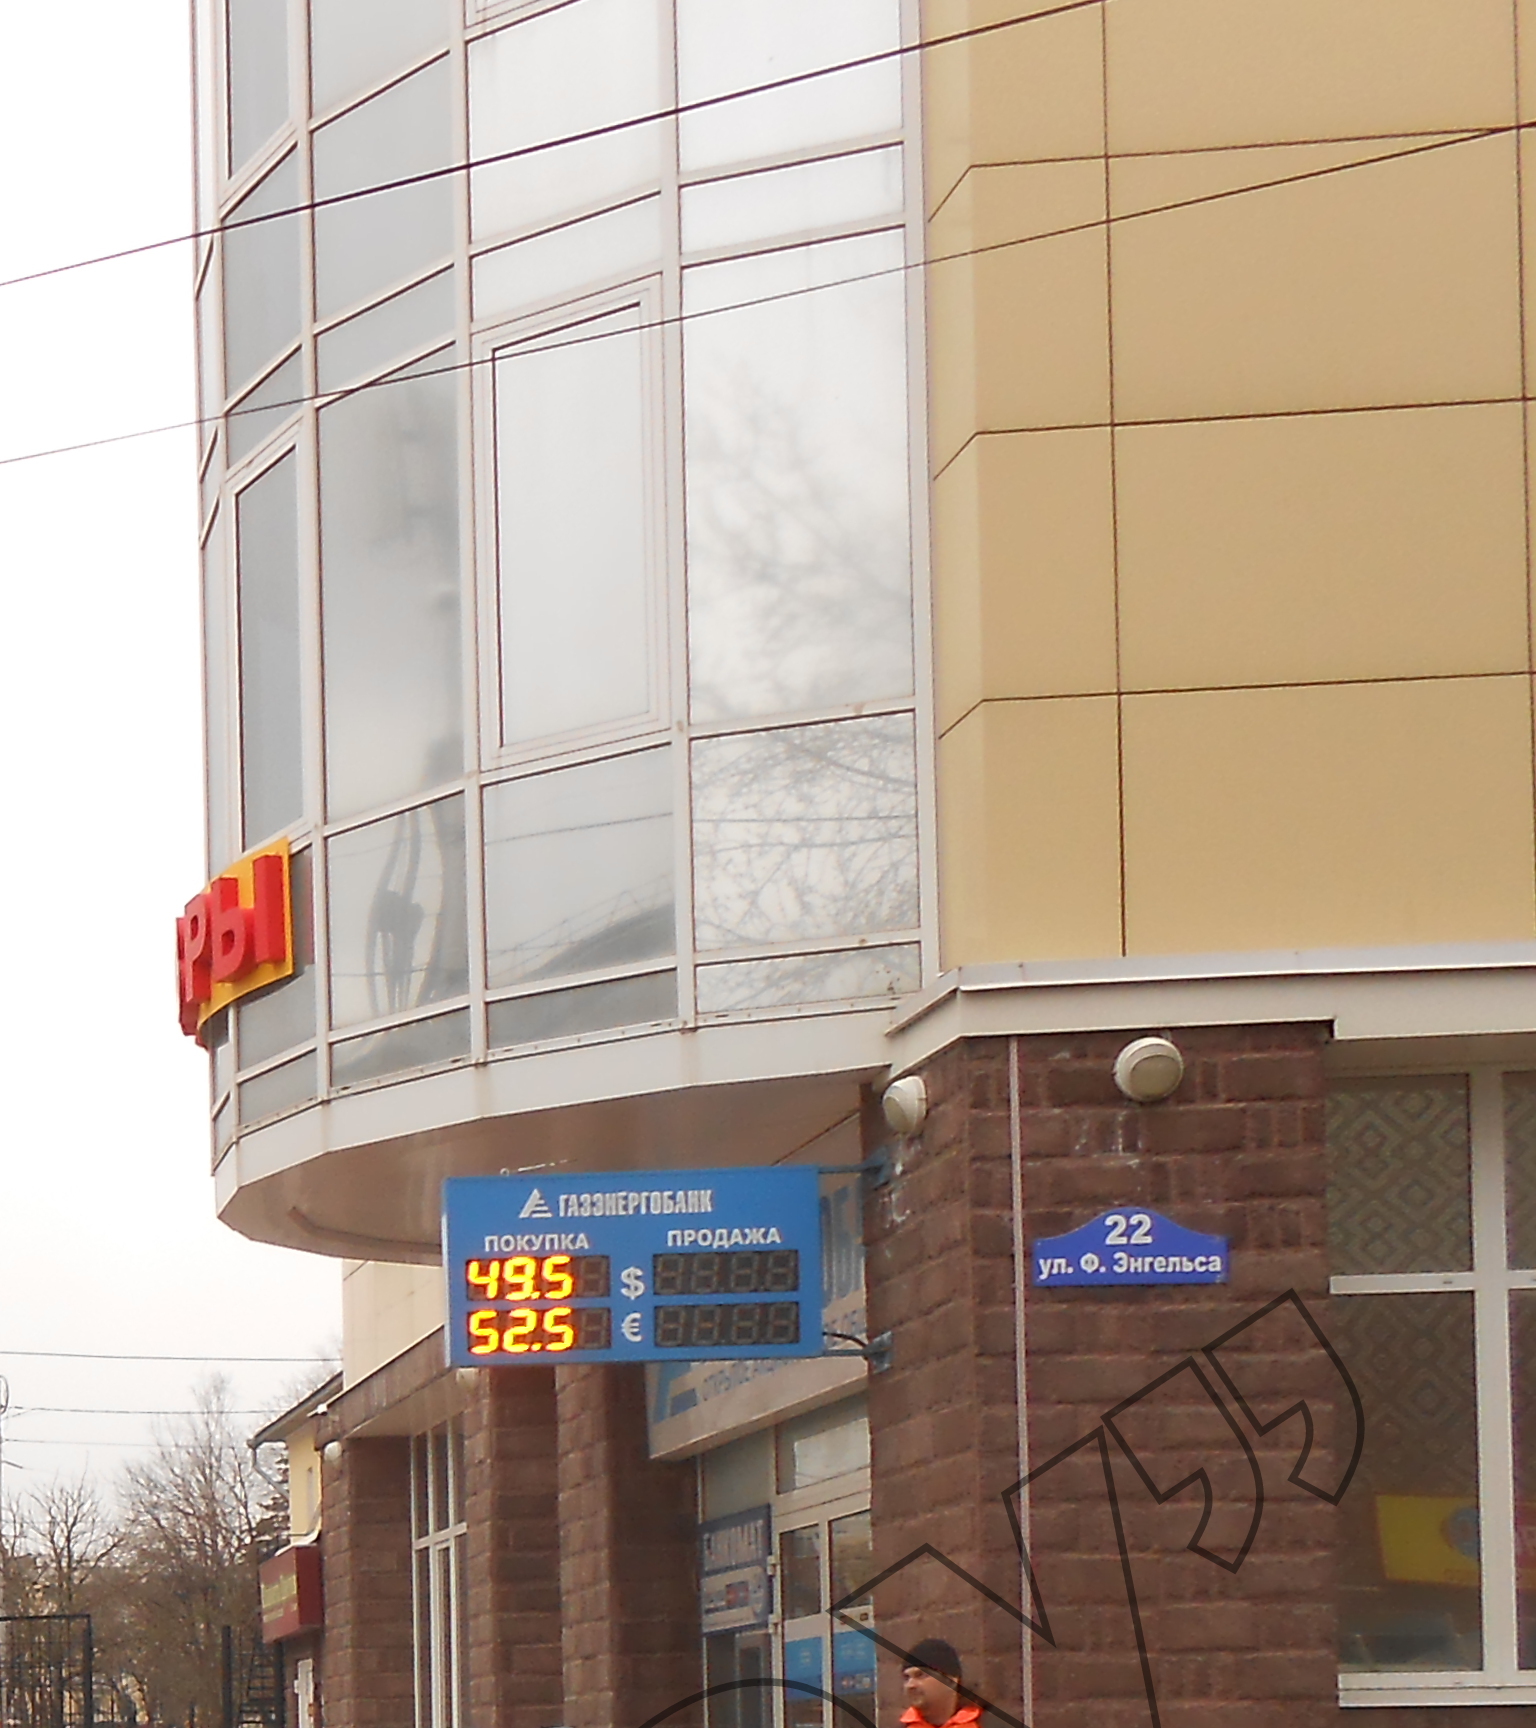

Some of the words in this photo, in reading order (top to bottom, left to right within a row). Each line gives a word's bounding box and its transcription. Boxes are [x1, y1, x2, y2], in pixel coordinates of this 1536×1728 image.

[176, 853, 286, 1050] РЫ
[558, 1189, 713, 1218] ГАЗЭНЕРГОБАНК
[484, 1232, 589, 1252] ПОКУПКА
[667, 1227, 782, 1249] ПРОДАЖА
[1105, 1214, 1153, 1245] 22
[467, 1255, 575, 1301] 49.5
[620, 1266, 645, 1300] $
[1039, 1257, 1074, 1280] ул.
[1080, 1252, 1106, 1274] Ф.
[1113, 1254, 1222, 1273] Энгельса
[467, 1307, 576, 1355] 52.5
[621, 1312, 643, 1342] €
